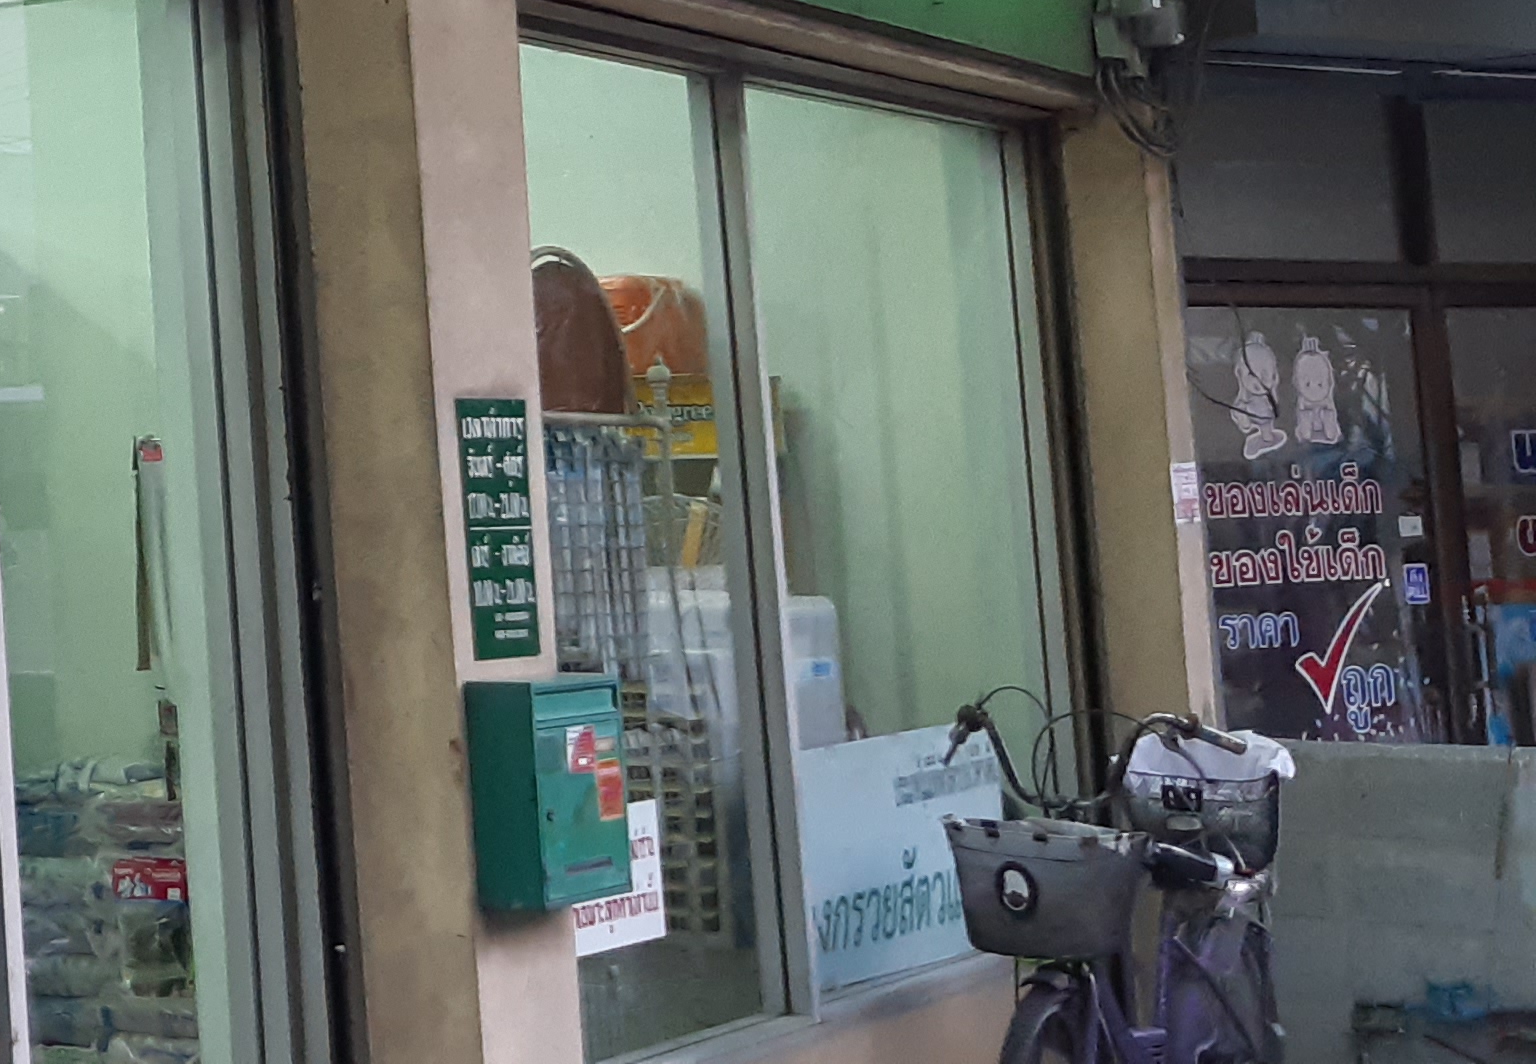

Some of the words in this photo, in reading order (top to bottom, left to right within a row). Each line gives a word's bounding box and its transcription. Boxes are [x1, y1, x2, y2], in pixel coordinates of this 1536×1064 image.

[1204, 462, 1384, 519] ของเล่นเด็ก
[1208, 524, 1387, 588] ของใช้เด็ก
[1218, 611, 1301, 650] ราคา
[1341, 662, 1396, 733] ถูก
